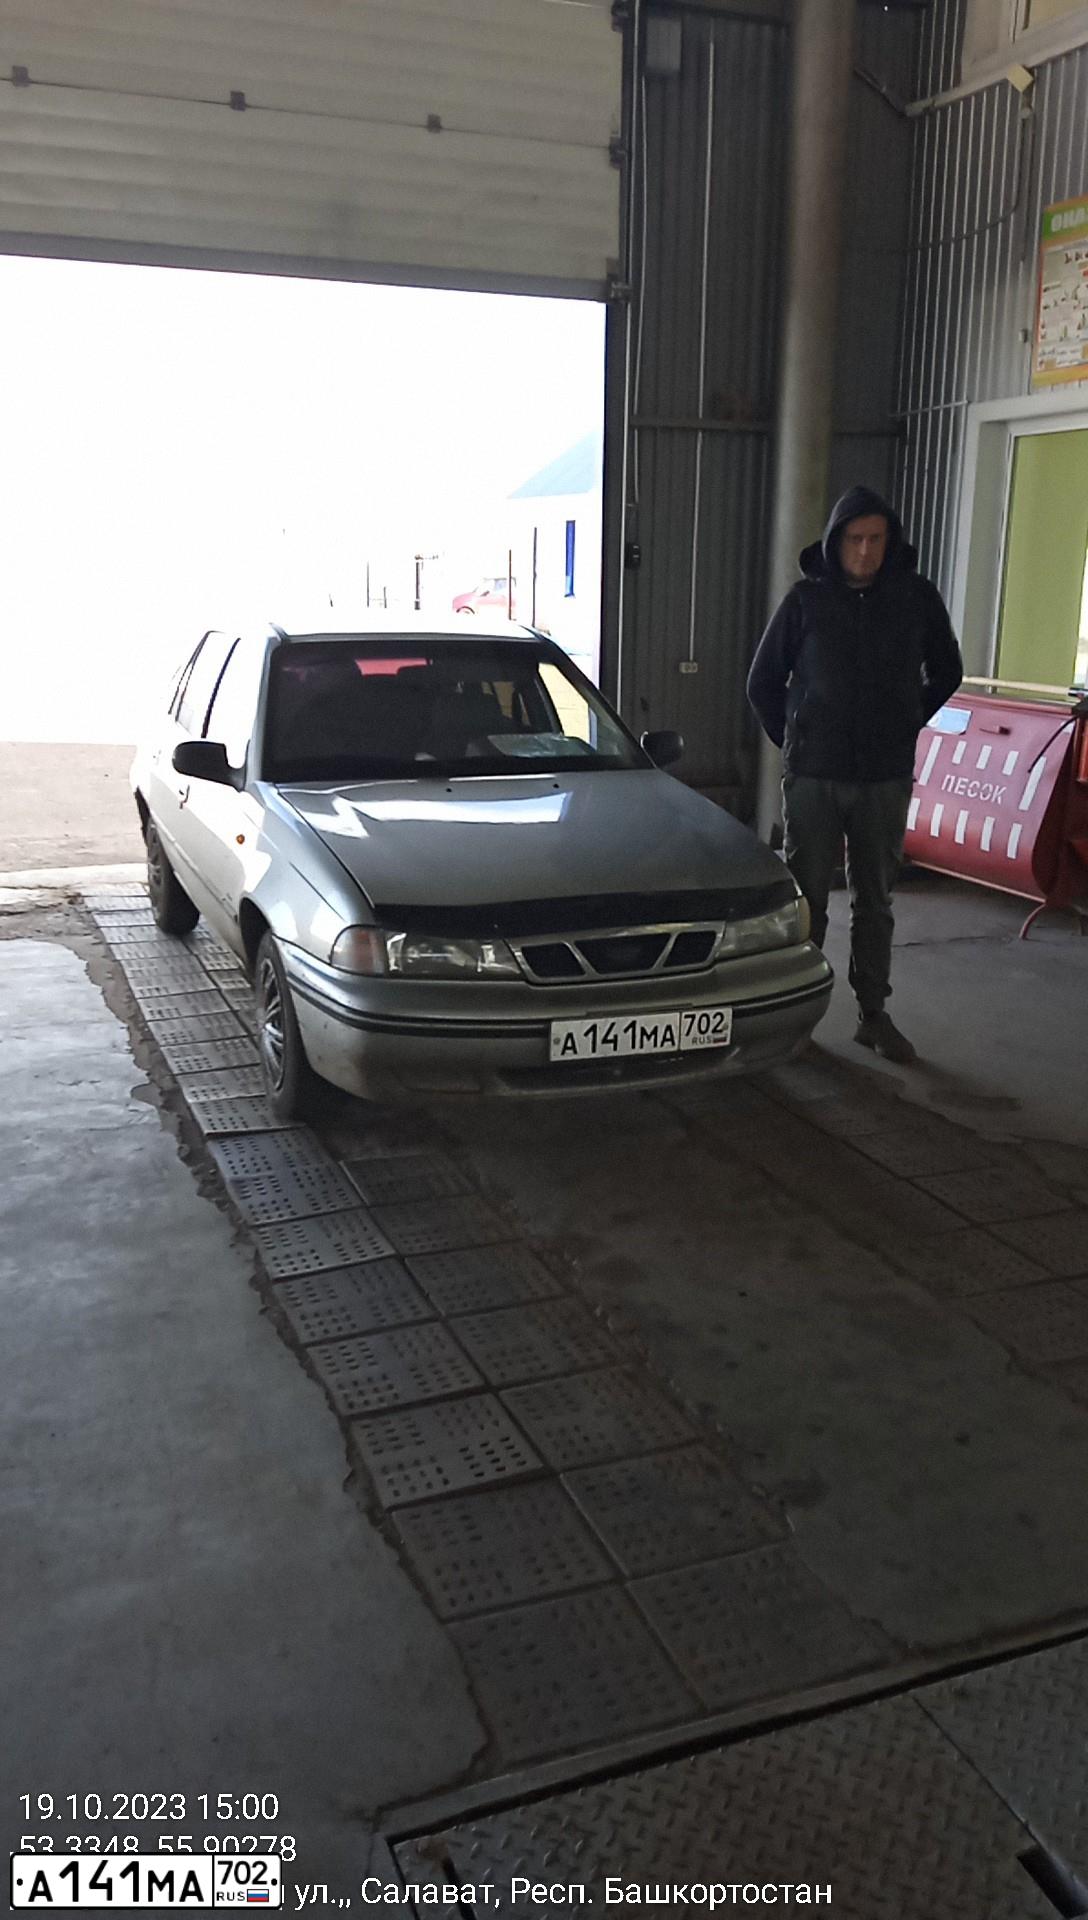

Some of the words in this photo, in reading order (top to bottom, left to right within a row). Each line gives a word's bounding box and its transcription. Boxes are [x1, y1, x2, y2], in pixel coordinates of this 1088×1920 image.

[941, 774, 1007, 805] ПЕСОК
[560, 1020, 676, 1056] А141МА
[684, 1011, 725, 1037] 702
[691, 1036, 712, 1046] RUS
